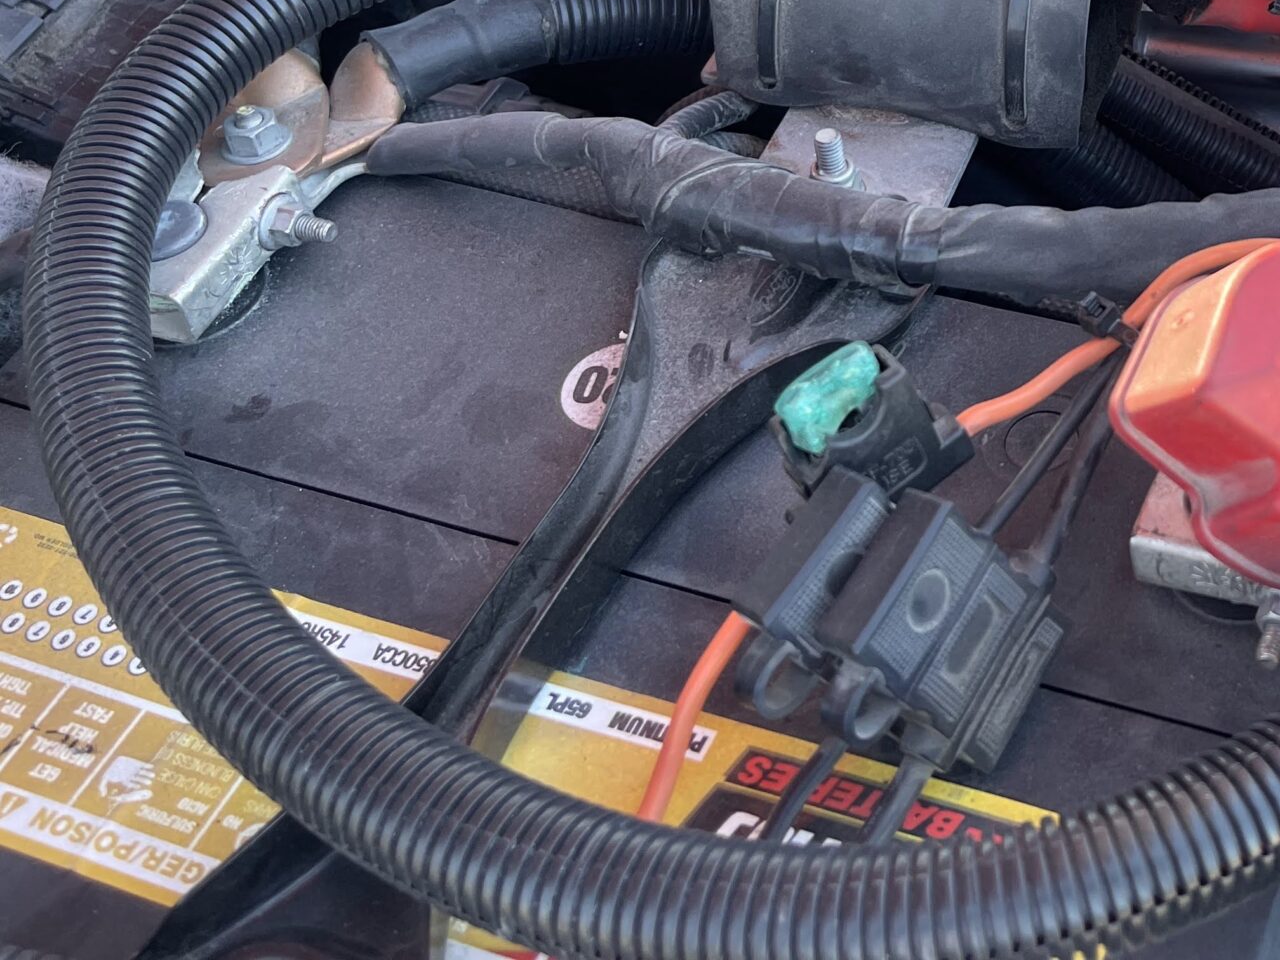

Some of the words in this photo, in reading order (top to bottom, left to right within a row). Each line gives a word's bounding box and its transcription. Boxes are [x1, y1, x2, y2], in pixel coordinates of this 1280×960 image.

[73, 700, 115, 724] FAST
[545, 692, 594, 720] 65PL
[58, 721, 99, 743] HELP
[607, 711, 709, 754] PTINUM
[29, 735, 96, 769] MEDICAL
[28, 762, 61, 783] GET
[176, 797, 209, 816] ACID
[736, 753, 966, 840] BATERES
[27, 806, 207, 885] GER/POISON
